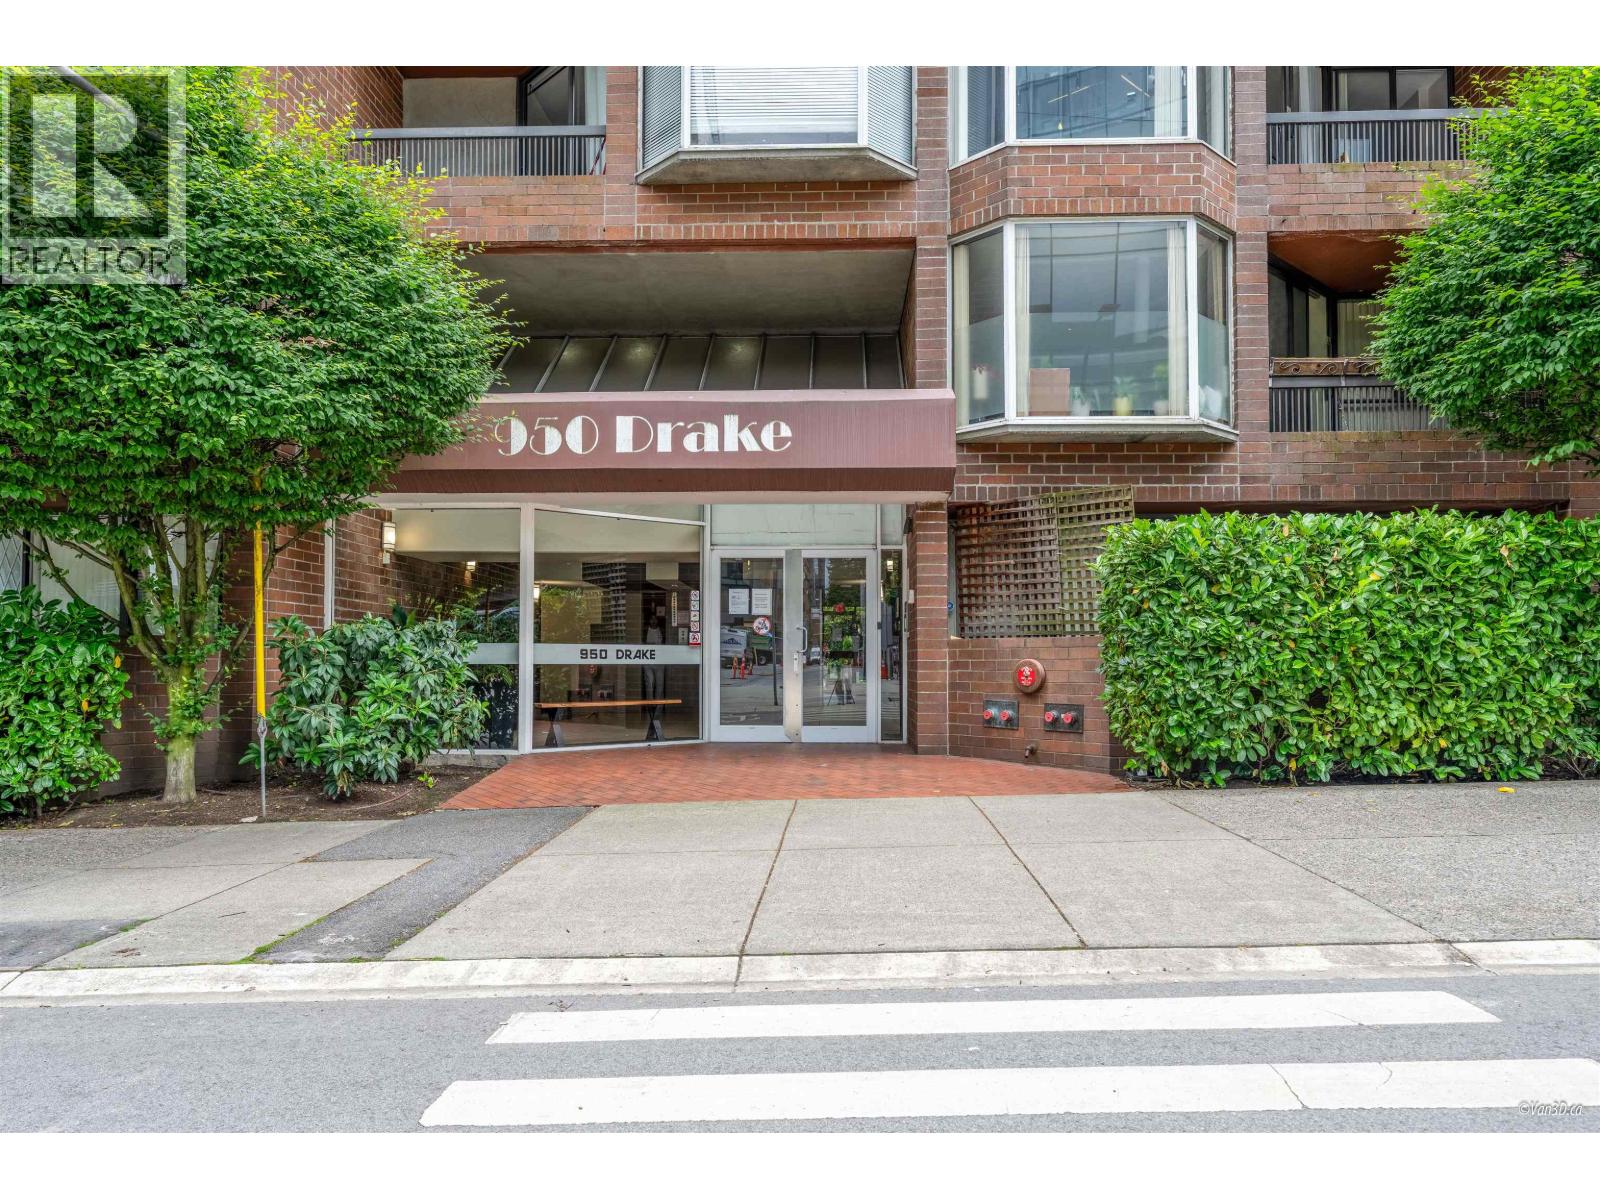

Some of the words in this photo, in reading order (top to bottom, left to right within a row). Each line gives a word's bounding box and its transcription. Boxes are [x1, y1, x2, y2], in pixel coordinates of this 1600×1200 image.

[494, 415, 599, 456] 950
[615, 414, 793, 453] Drake
[579, 648, 608, 660] 950
[615, 649, 656, 660] DRAKE
